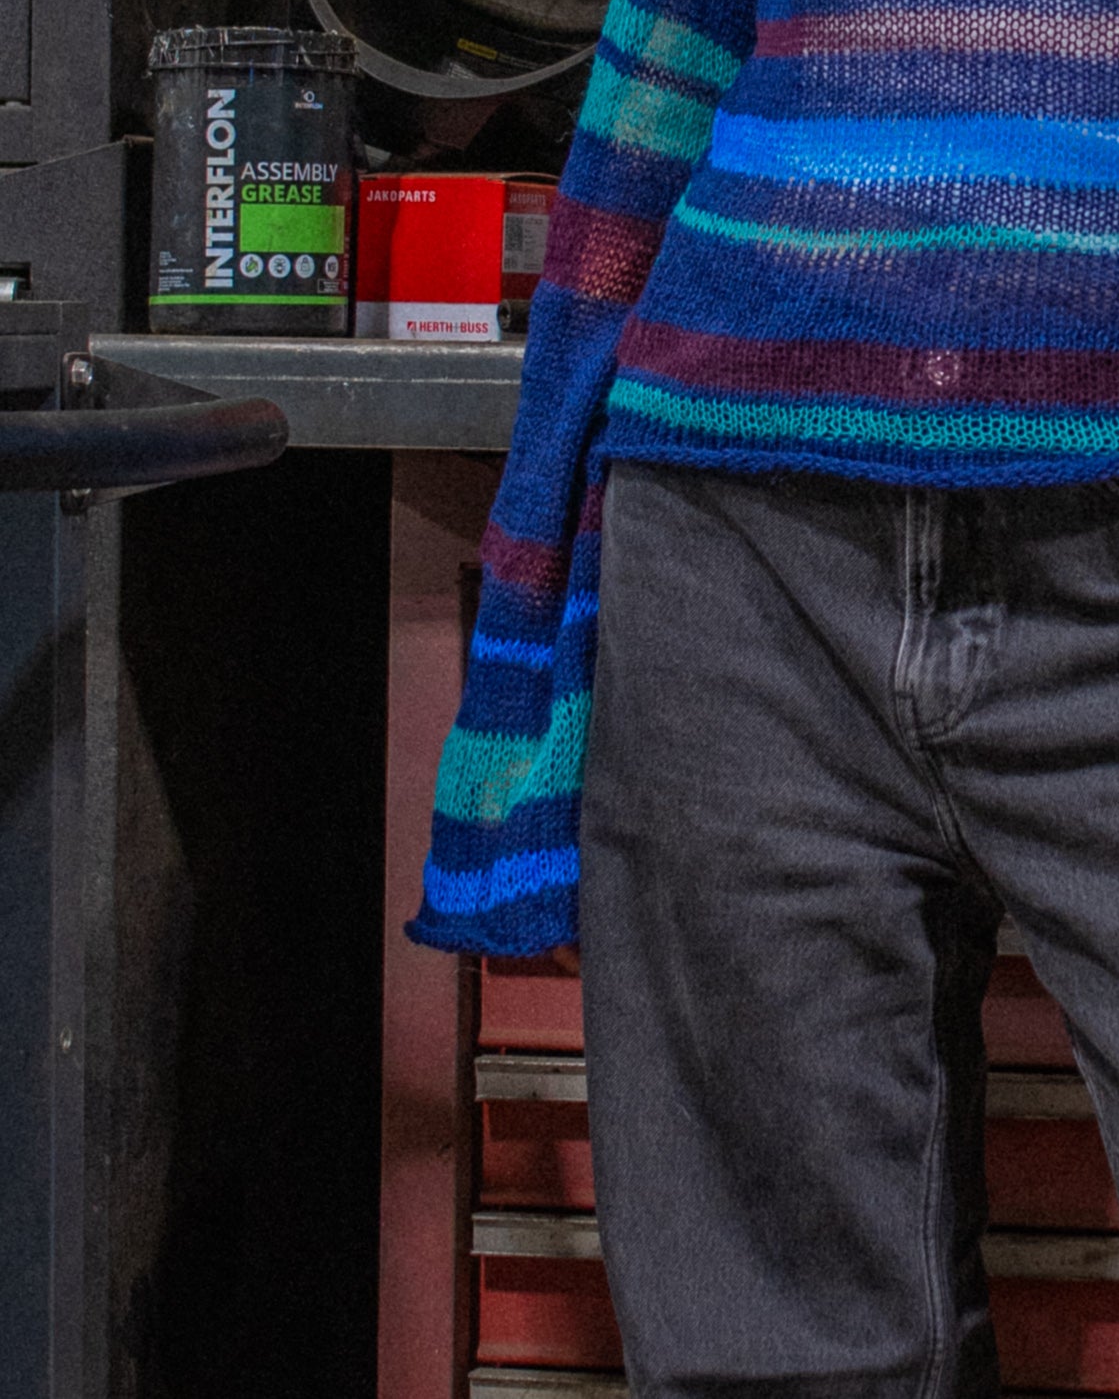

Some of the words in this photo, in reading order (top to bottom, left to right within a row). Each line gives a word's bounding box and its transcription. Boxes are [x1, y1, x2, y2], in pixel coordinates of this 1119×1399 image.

[241, 161, 339, 182] ASSEMBLY
[205, 89, 236, 288] INTERFLON
[241, 183, 322, 204] GREASE
[367, 189, 437, 203] JAKOPARTS
